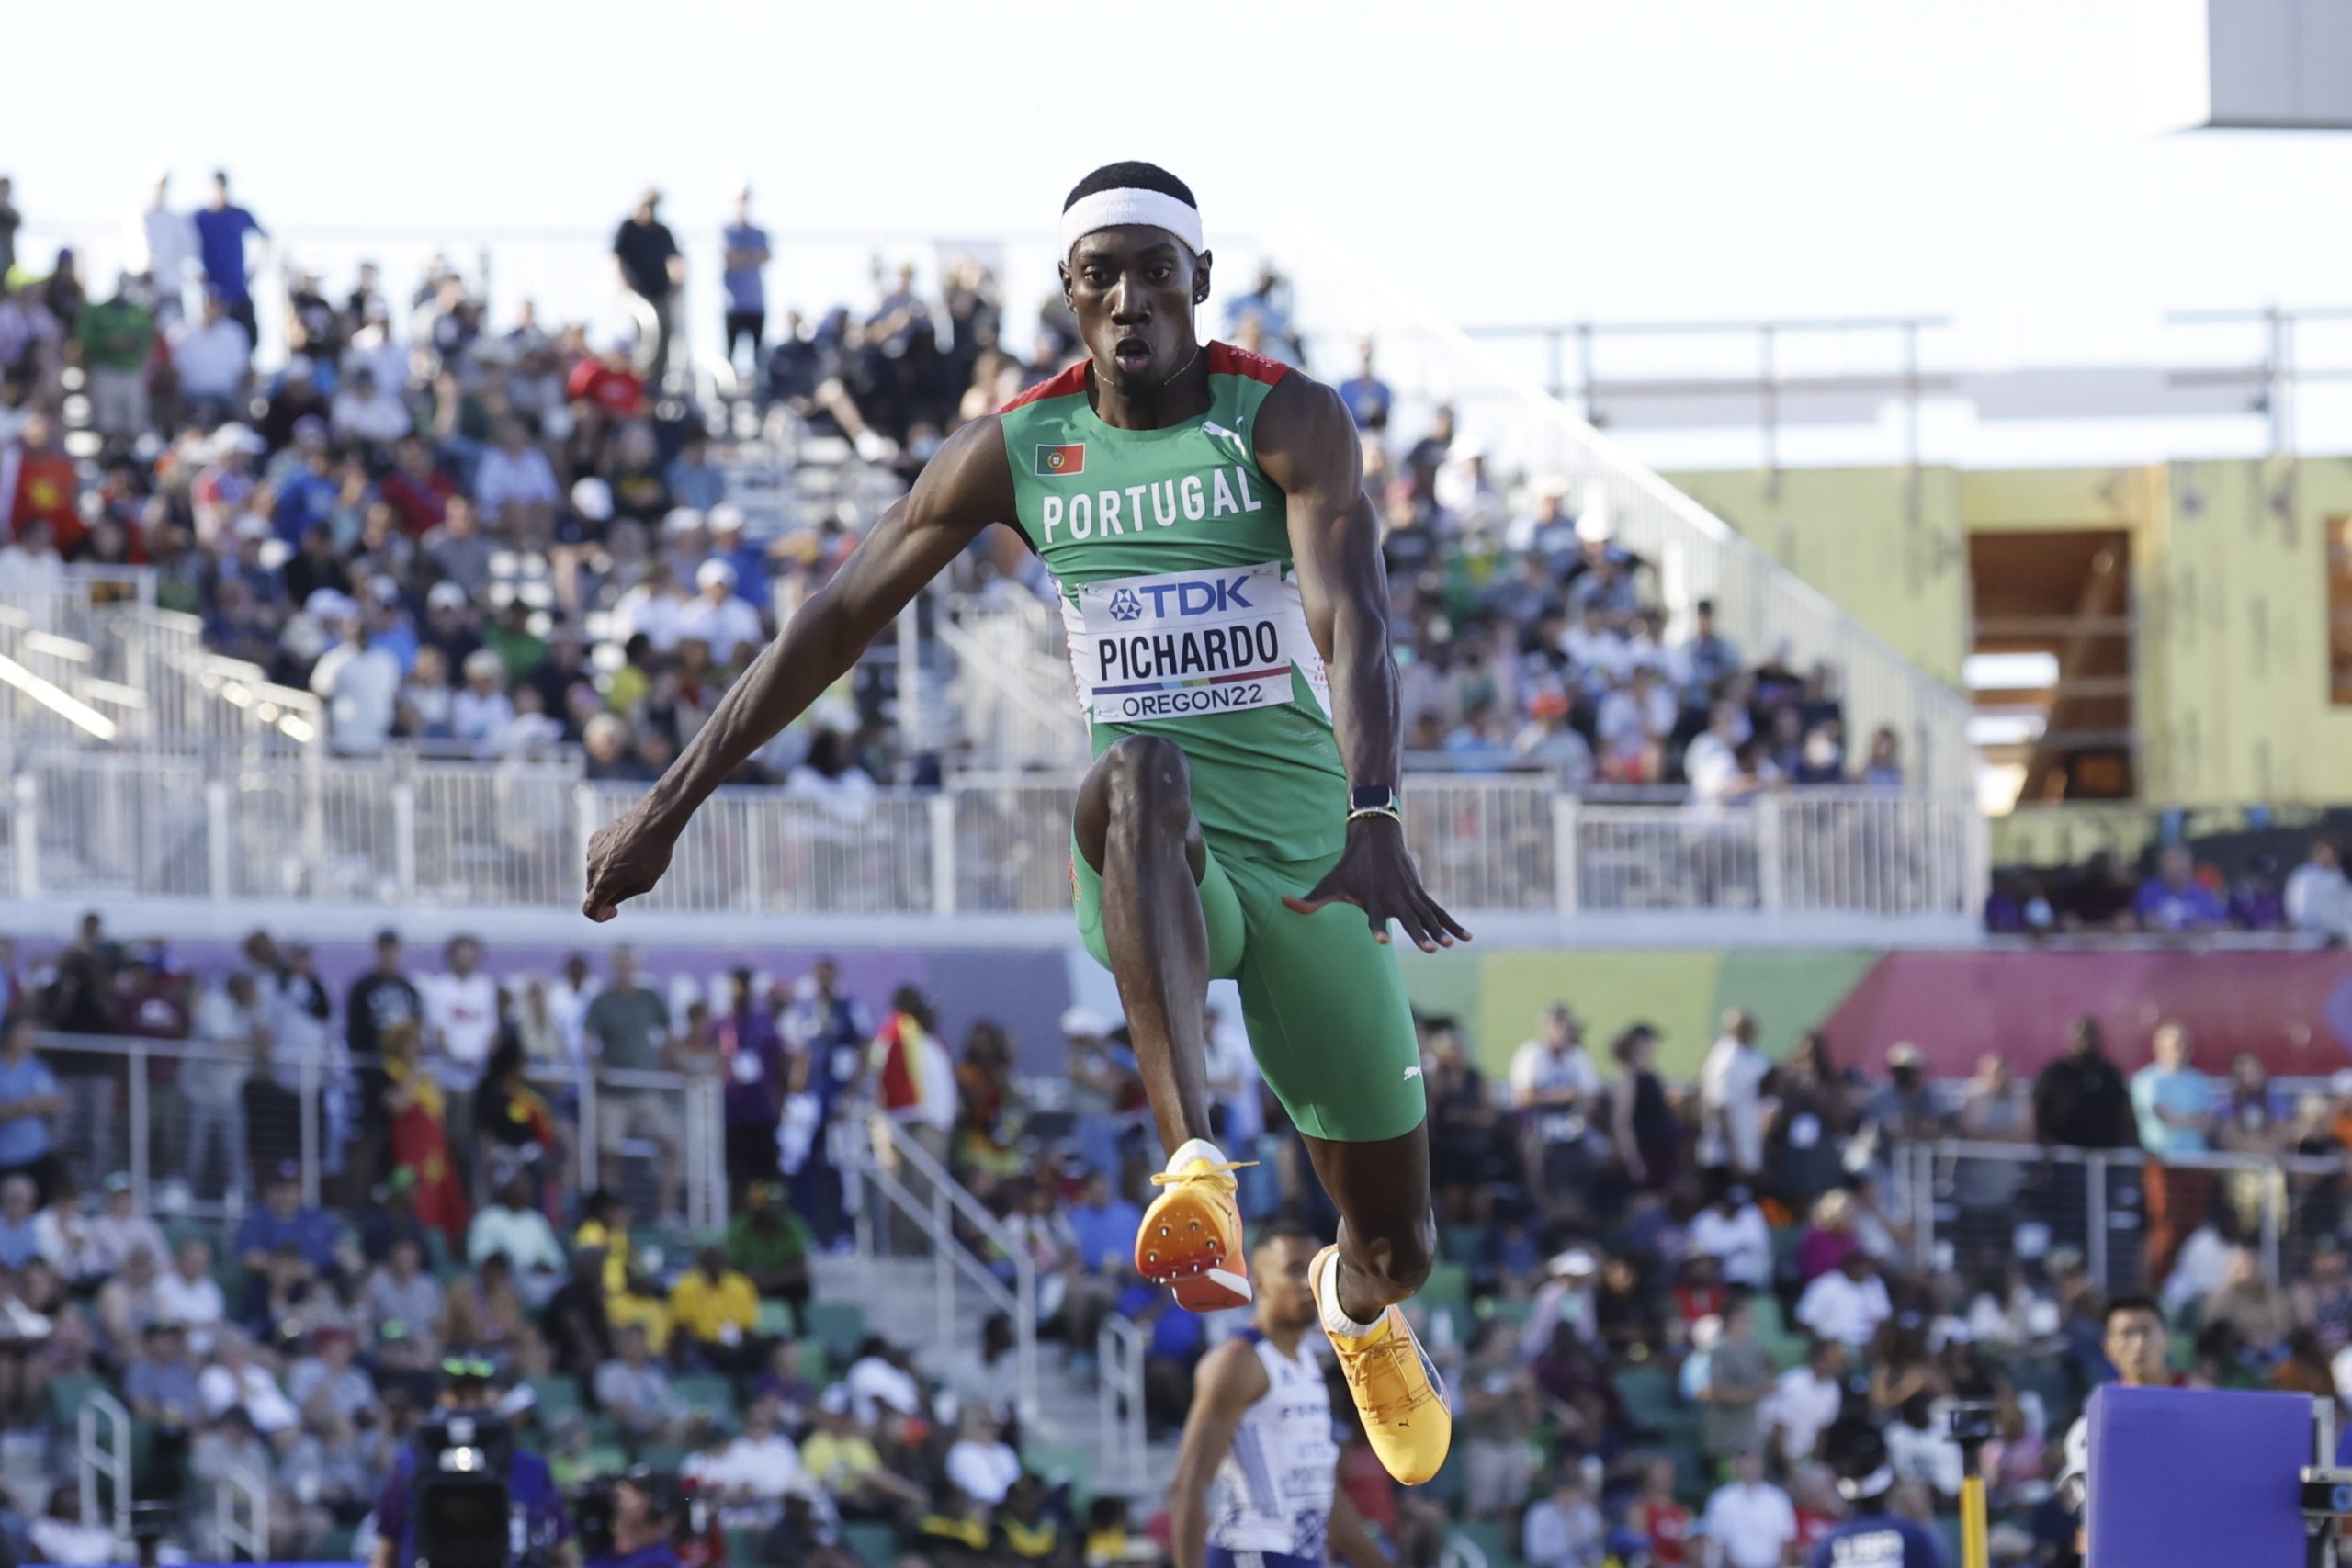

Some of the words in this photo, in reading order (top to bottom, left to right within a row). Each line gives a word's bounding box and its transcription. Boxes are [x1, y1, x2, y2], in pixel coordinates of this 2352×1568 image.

[1043, 466, 1261, 544] PORTUGAL
[1139, 575, 1253, 618] TDK
[1099, 621, 1278, 681] PICHARDO
[1123, 683, 1262, 716] OREGON22
